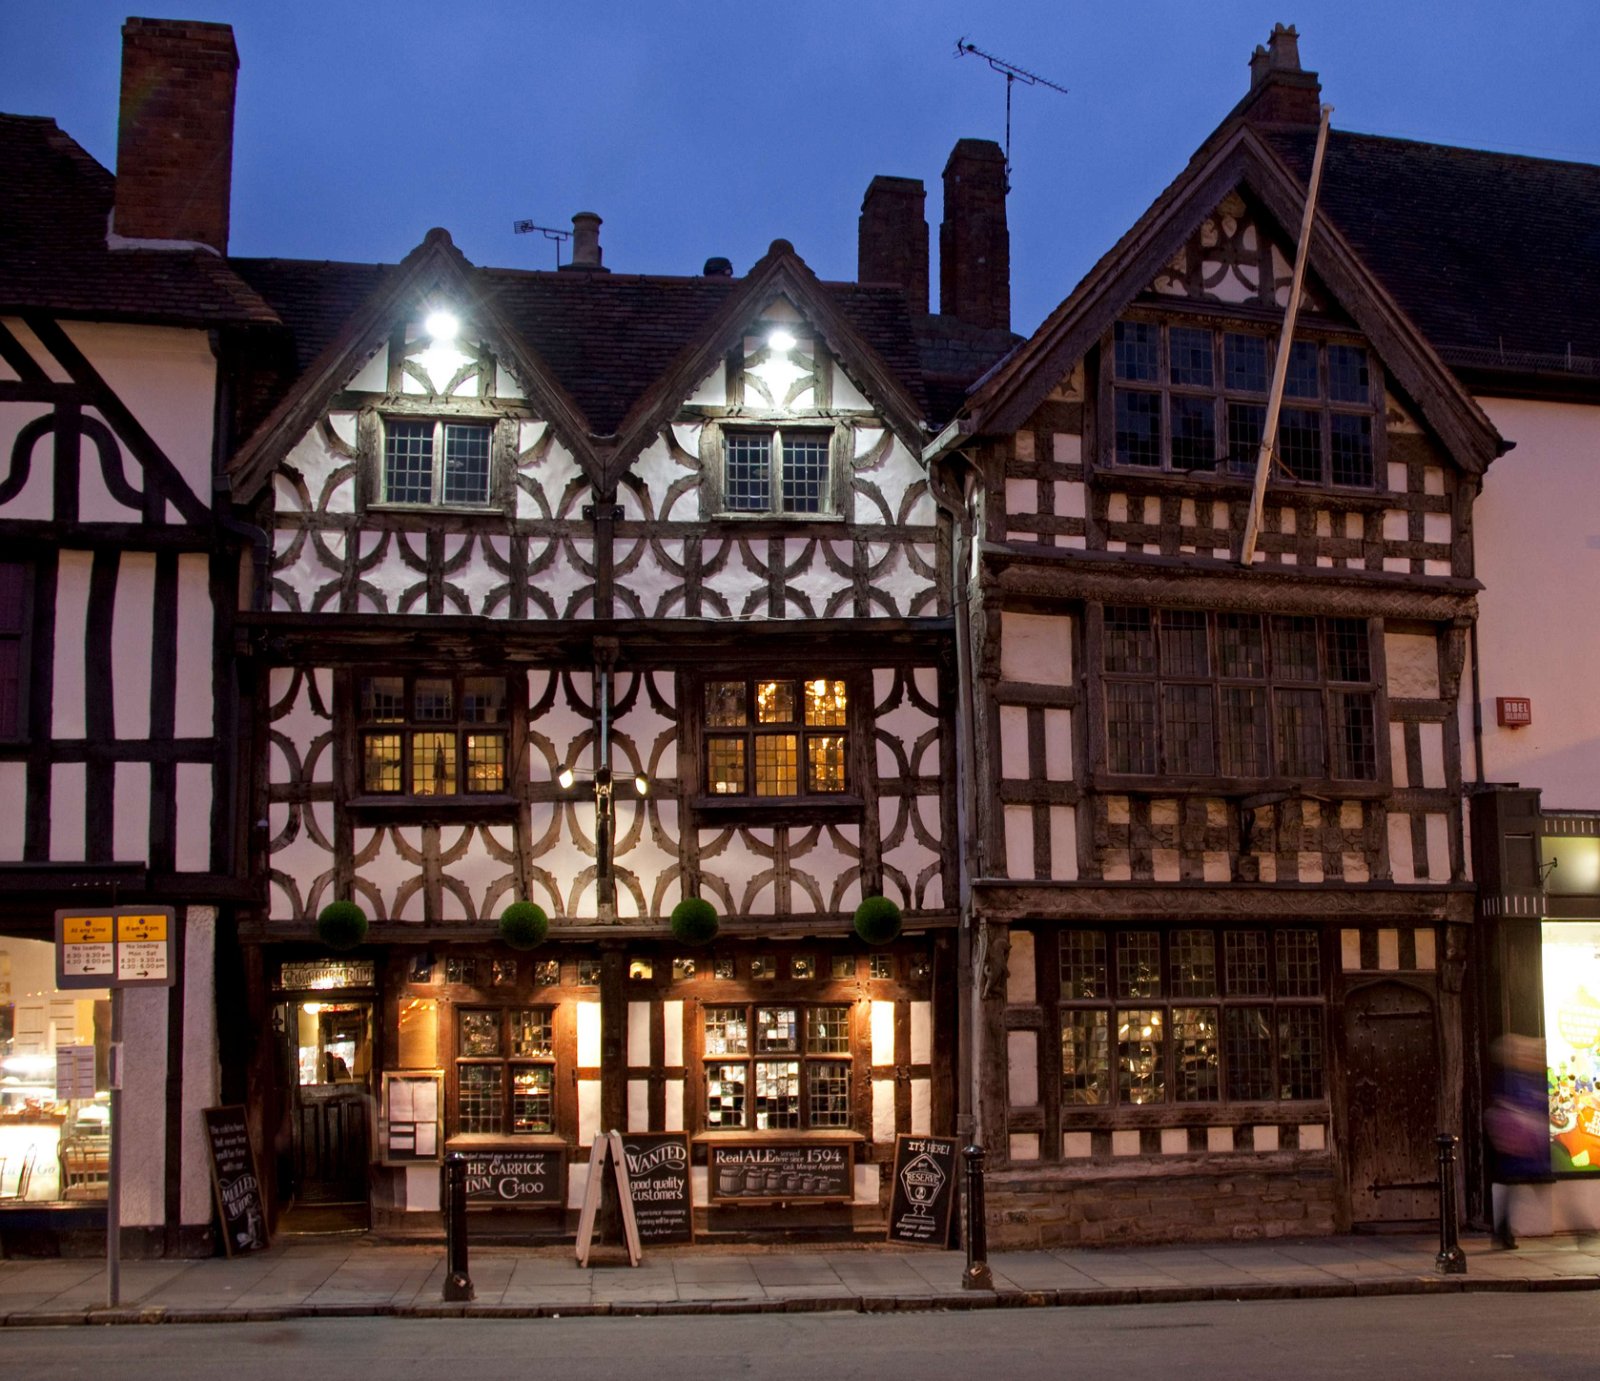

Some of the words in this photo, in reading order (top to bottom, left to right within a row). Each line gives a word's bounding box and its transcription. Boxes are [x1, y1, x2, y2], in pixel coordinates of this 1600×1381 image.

[1504, 702, 1528, 713] ABEL
[927, 1143, 950, 1155] HERE!
[625, 1145, 687, 1174] WANTED
[715, 1149, 743, 1164] Real
[743, 1149, 776, 1163] ALE
[806, 1149, 841, 1163] 1594
[467, 1162, 487, 1175] HE
[489, 1162, 546, 1176] GARRICK
[818, 1162, 845, 1171] Approved
[466, 1176, 492, 1193] INN
[630, 1178, 651, 1192] good
[652, 1175, 685, 1192] quality
[907, 1173, 939, 1183] RESERVE
[221, 1176, 258, 1203] MULLED
[631, 1189, 684, 1201] customers
[228, 1192, 253, 1217] Wine
